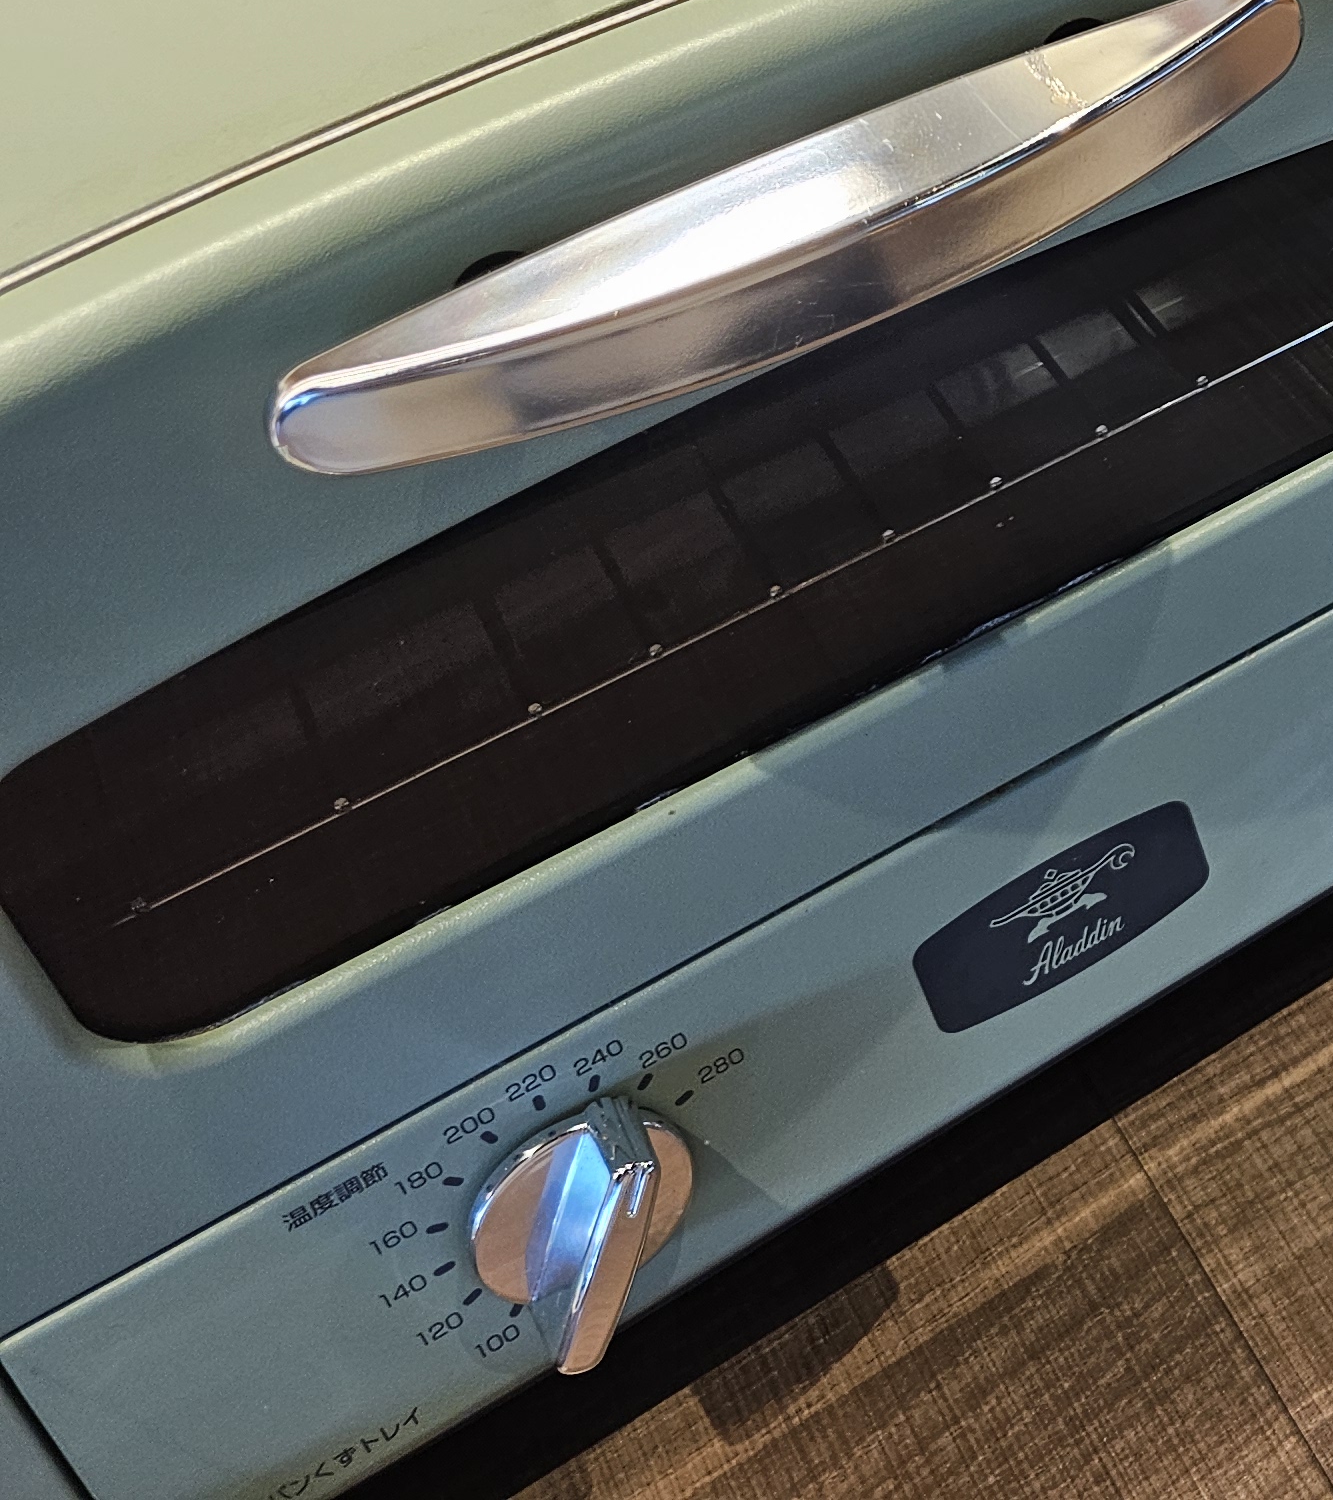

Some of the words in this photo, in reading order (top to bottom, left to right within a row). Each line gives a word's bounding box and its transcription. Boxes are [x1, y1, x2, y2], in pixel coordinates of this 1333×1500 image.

[1022, 915, 1125, 986] Aladdin
[573, 1039, 624, 1077] 240
[638, 1031, 688, 1069] 260
[697, 1047, 745, 1085] 280
[505, 1064, 558, 1102] 220
[442, 1106, 495, 1144] 200
[282, 1161, 389, 1233] 温度調節
[394, 1161, 444, 1198] 180
[368, 1221, 419, 1256] 160
[378, 1273, 428, 1309] 140
[415, 1312, 465, 1347] 120
[473, 1324, 521, 1359] 100
